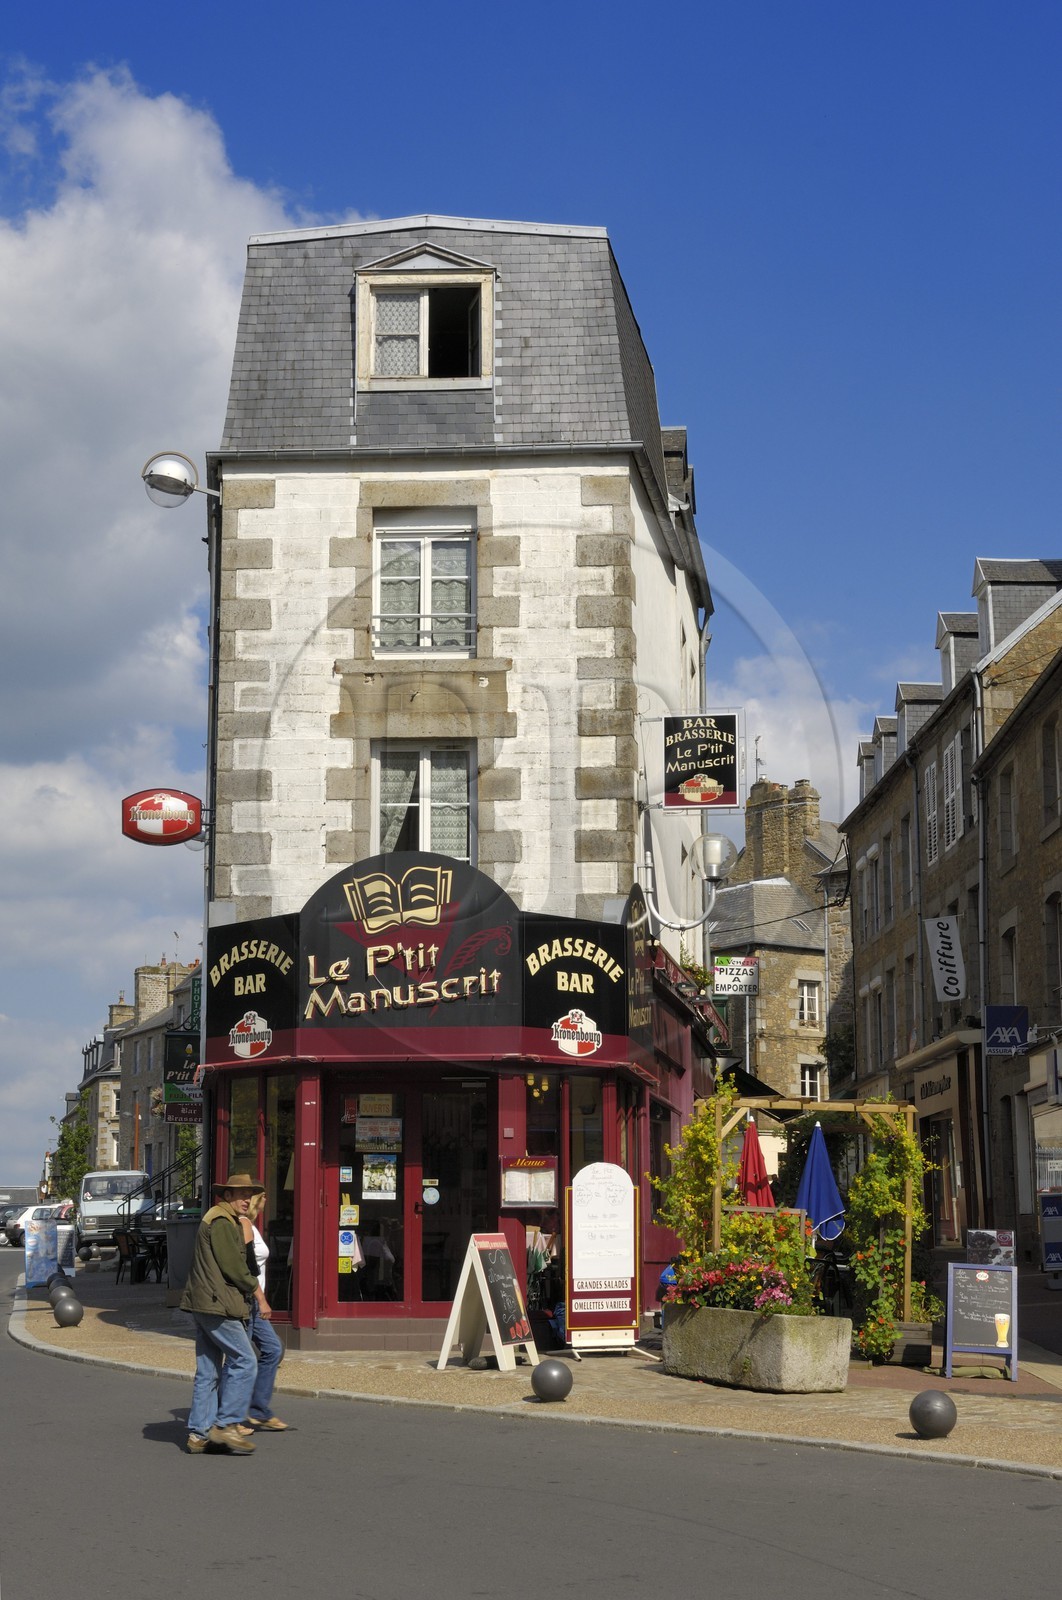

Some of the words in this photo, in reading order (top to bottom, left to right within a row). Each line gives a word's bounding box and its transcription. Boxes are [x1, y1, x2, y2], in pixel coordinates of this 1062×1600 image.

[683, 718, 717, 729] BAR
[666, 729, 735, 747] BRASSERIE
[677, 747, 692, 759] Le
[697, 743, 723, 756] P'tit
[666, 754, 735, 774] Manuscrit
[680, 785, 724, 796] Kronenbourg
[130, 806, 195, 824] Kronenbourg
[209, 939, 295, 988] BRASSERIE
[308, 955, 350, 986] Le
[366, 942, 440, 977] P'tit
[525, 937, 625, 984] BRASSERIE
[936, 921, 961, 998] Coiffure
[719, 967, 755, 976] PIZZAS
[234, 973, 266, 996] BAR
[556, 970, 595, 995] BAR
[715, 983, 758, 992] EMPORTER
[303, 967, 501, 1021] Manuscrit
[230, 1029, 272, 1045] Kronenbourg
[552, 1023, 602, 1047] Kronenbourg
[986, 1027, 1022, 1043] AXA
[183, 1060, 196, 1069] Le
[166, 1071, 190, 1080] P'tit
[361, 1103, 391, 1113] OUVERTS
[510, 1158, 546, 1167] Menus
[1042, 1206, 1059, 1216] AXA
[1046, 1253, 1062, 1262] AXA
[576, 1281, 603, 1290] GRANDES
[603, 1280, 629, 1289] SALADES
[574, 1301, 604, 1310] OMELETTES
[605, 1301, 628, 1309] VARIEES
